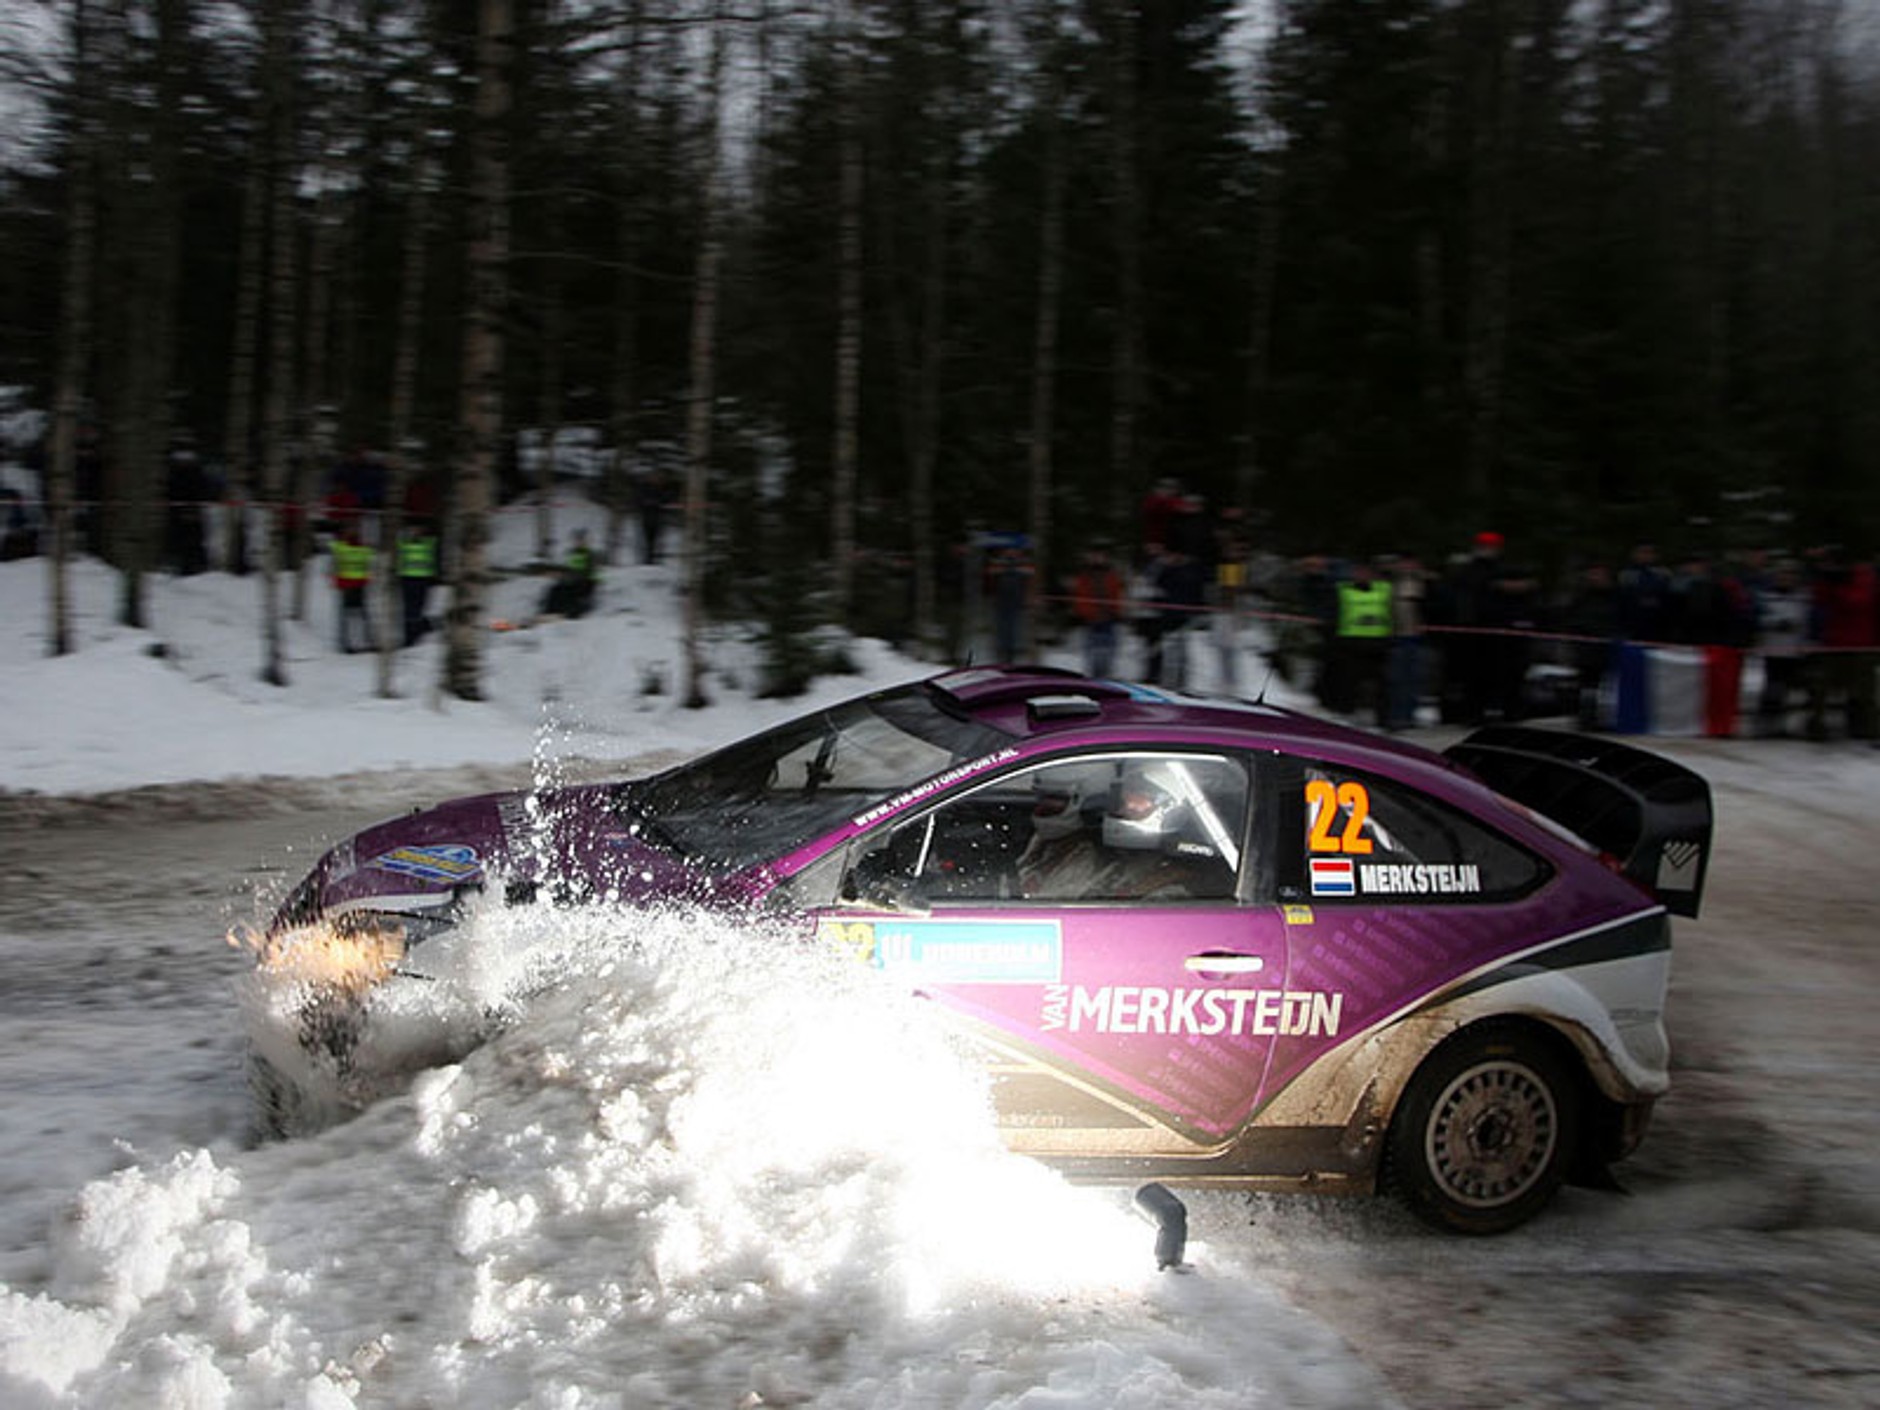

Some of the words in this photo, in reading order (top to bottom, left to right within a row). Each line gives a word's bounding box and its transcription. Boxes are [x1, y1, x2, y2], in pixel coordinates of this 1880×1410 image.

[1305, 779, 1374, 854] 22
[1360, 864, 1480, 893] MERKSTEIJN
[1040, 984, 1070, 1031] VAN
